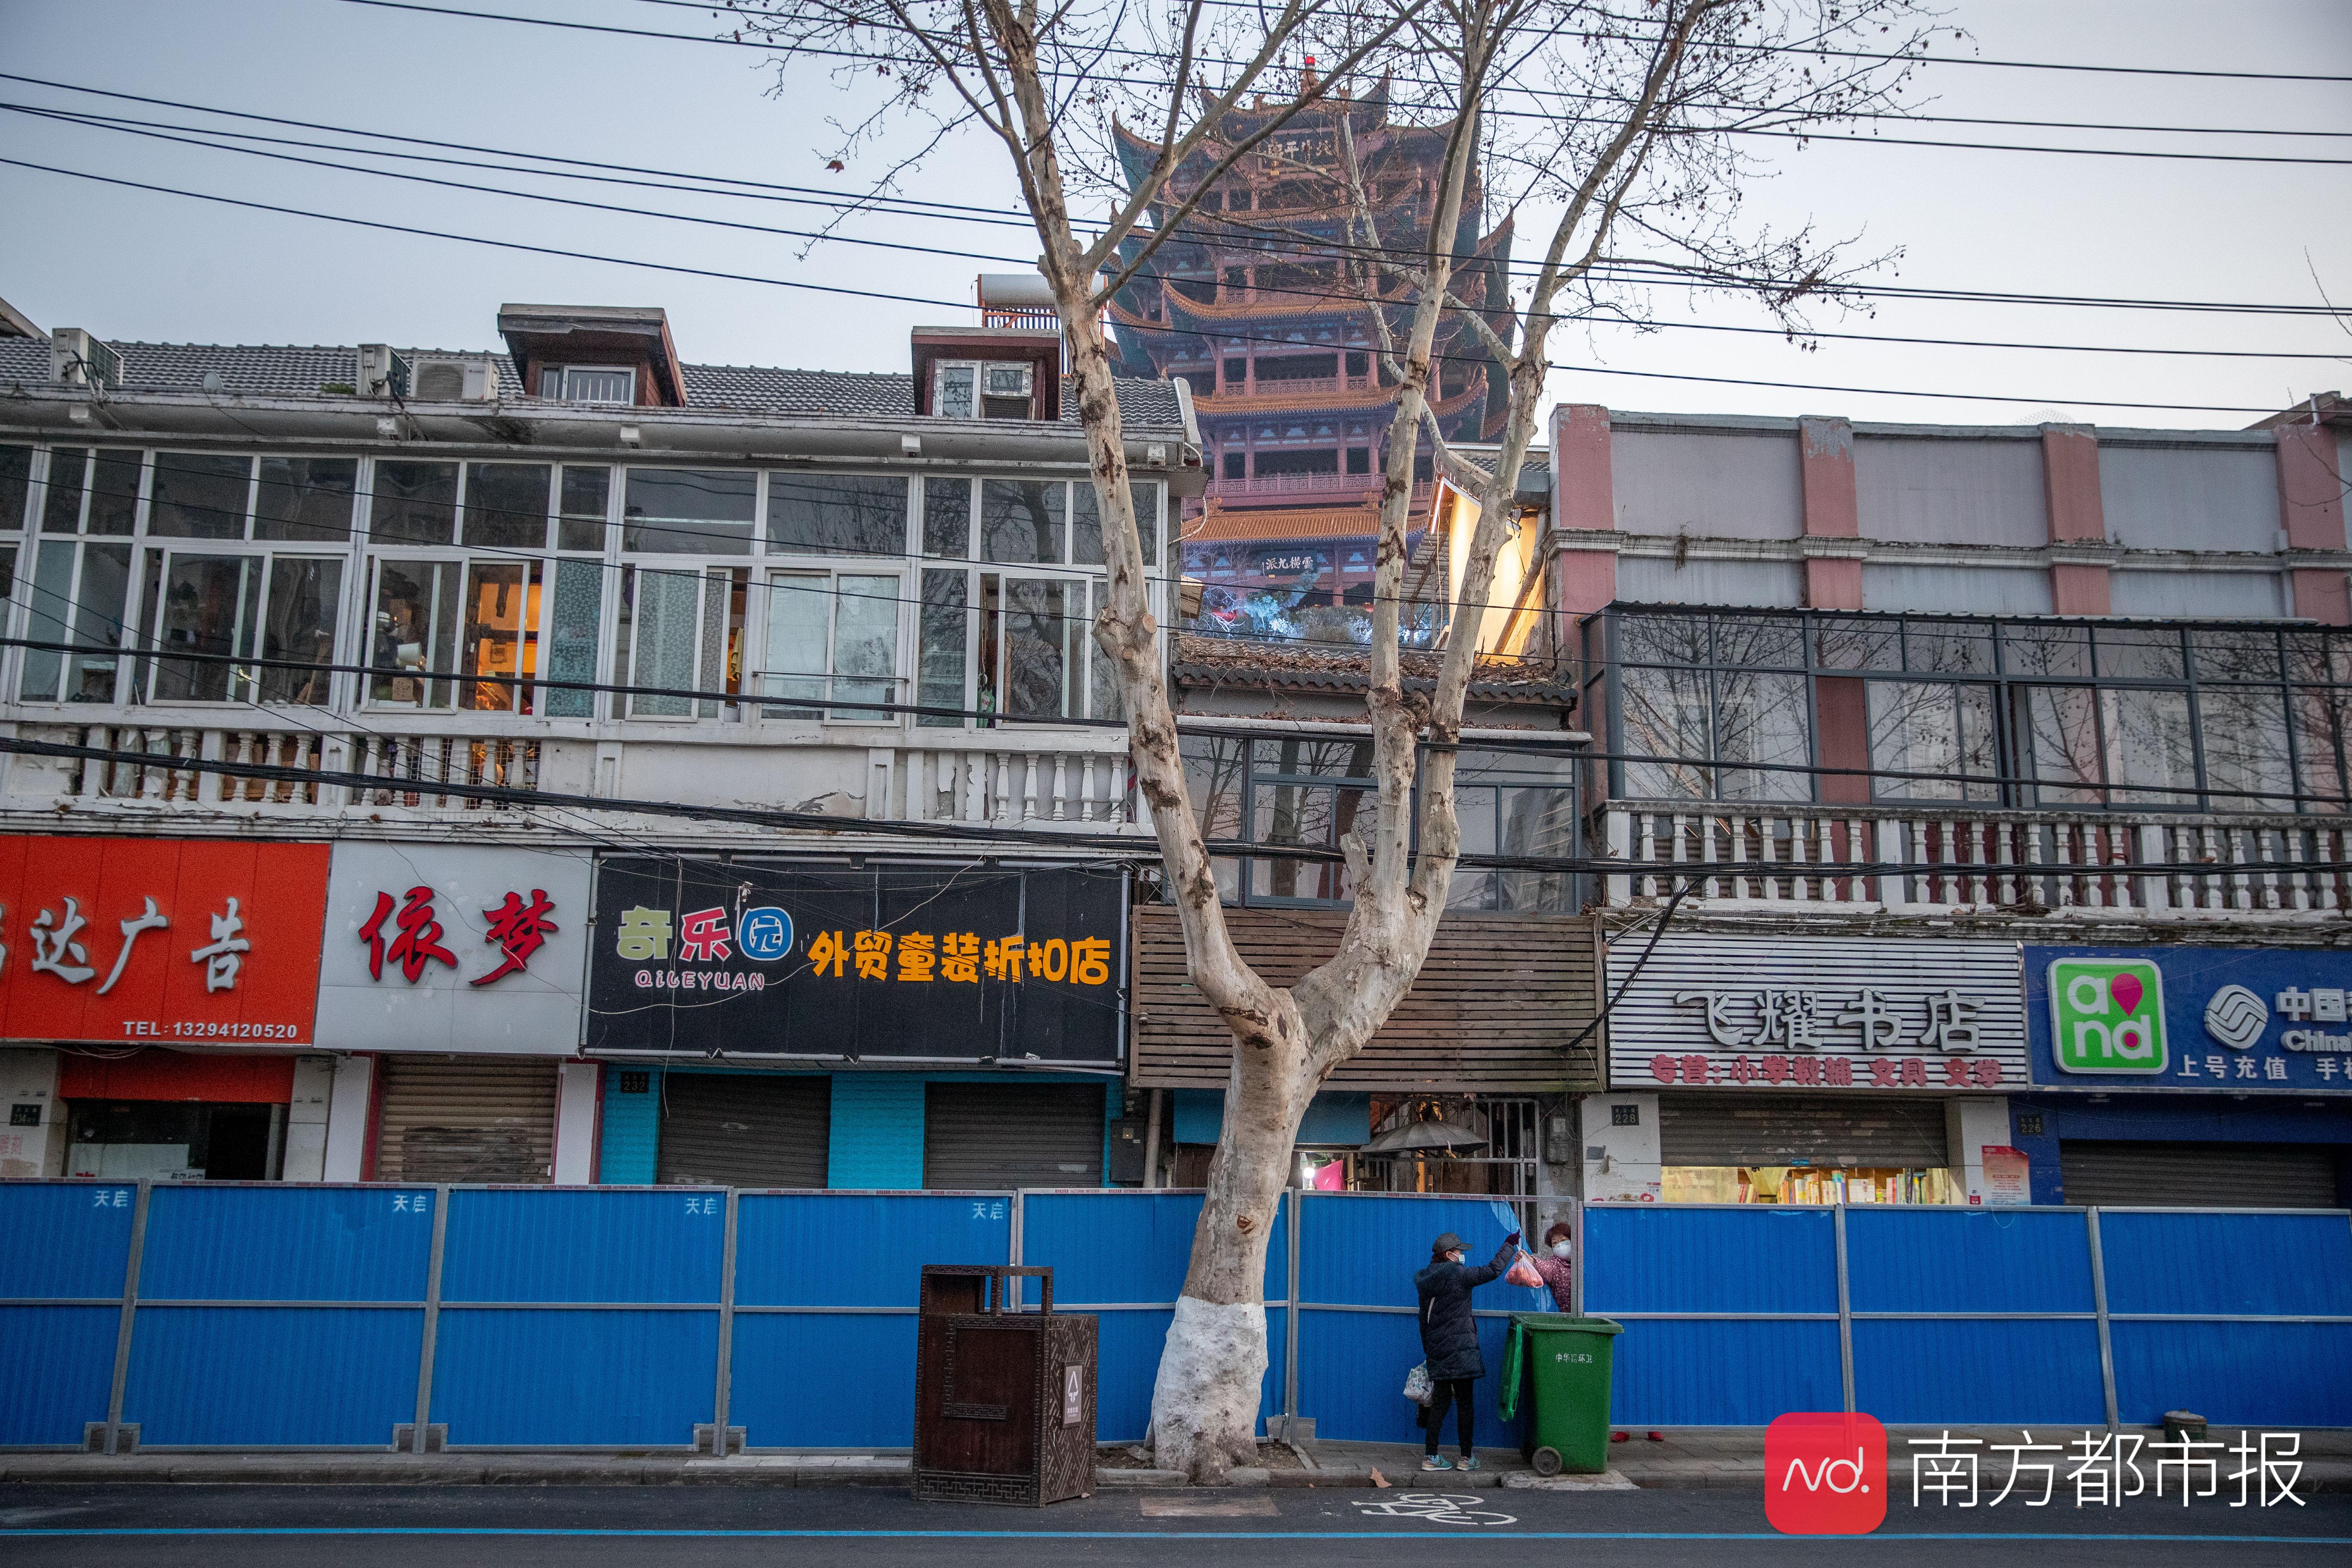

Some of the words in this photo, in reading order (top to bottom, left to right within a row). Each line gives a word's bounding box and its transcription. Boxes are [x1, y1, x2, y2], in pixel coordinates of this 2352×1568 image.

[0, 896, 251, 995] 达广告
[358, 886, 559, 986] 依梦
[616, 905, 793, 962] 奇乐园
[807, 930, 1110, 984] 外贸童装折扣店
[2275, 986, 2352, 1021] 中国
[1673, 988, 1986, 1051] 飞耀书店
[1868, 1057, 1928, 1087] 文具
[1943, 1058, 2003, 1087] 文学
[2177, 1055, 2288, 1080] 上号充值
[624, 1081, 645, 1090] 232
[1616, 1114, 1635, 1123] 228
[2021, 1124, 2040, 1132] 226
[94, 1190, 128, 1207] 天启
[393, 1195, 426, 1213] 天启
[686, 1198, 717, 1215] 天启
[973, 1202, 1003, 1220] 天启
